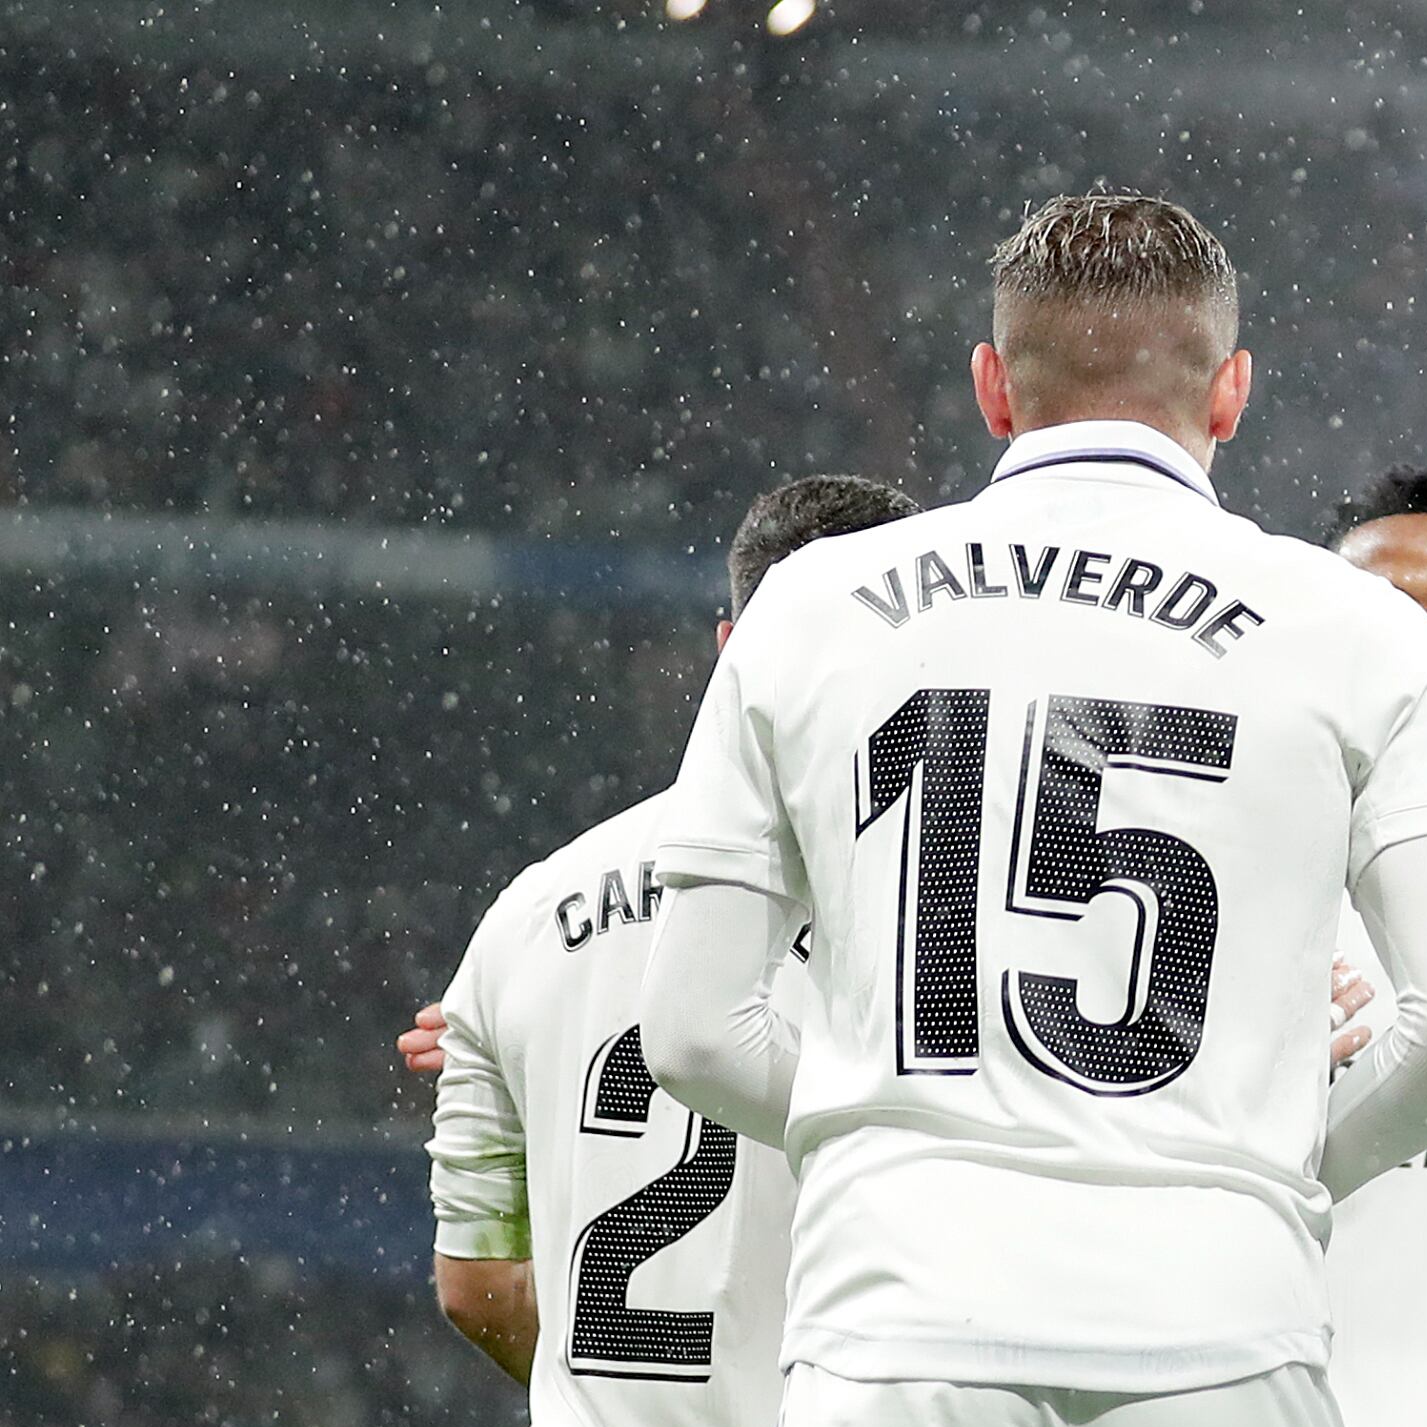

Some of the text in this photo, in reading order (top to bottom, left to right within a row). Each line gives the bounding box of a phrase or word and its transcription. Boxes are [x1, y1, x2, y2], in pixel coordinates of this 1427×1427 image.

[851, 542, 1266, 659] VALVERDE
[855, 688, 1239, 1098] 15
[567, 1022, 739, 1383] 2
